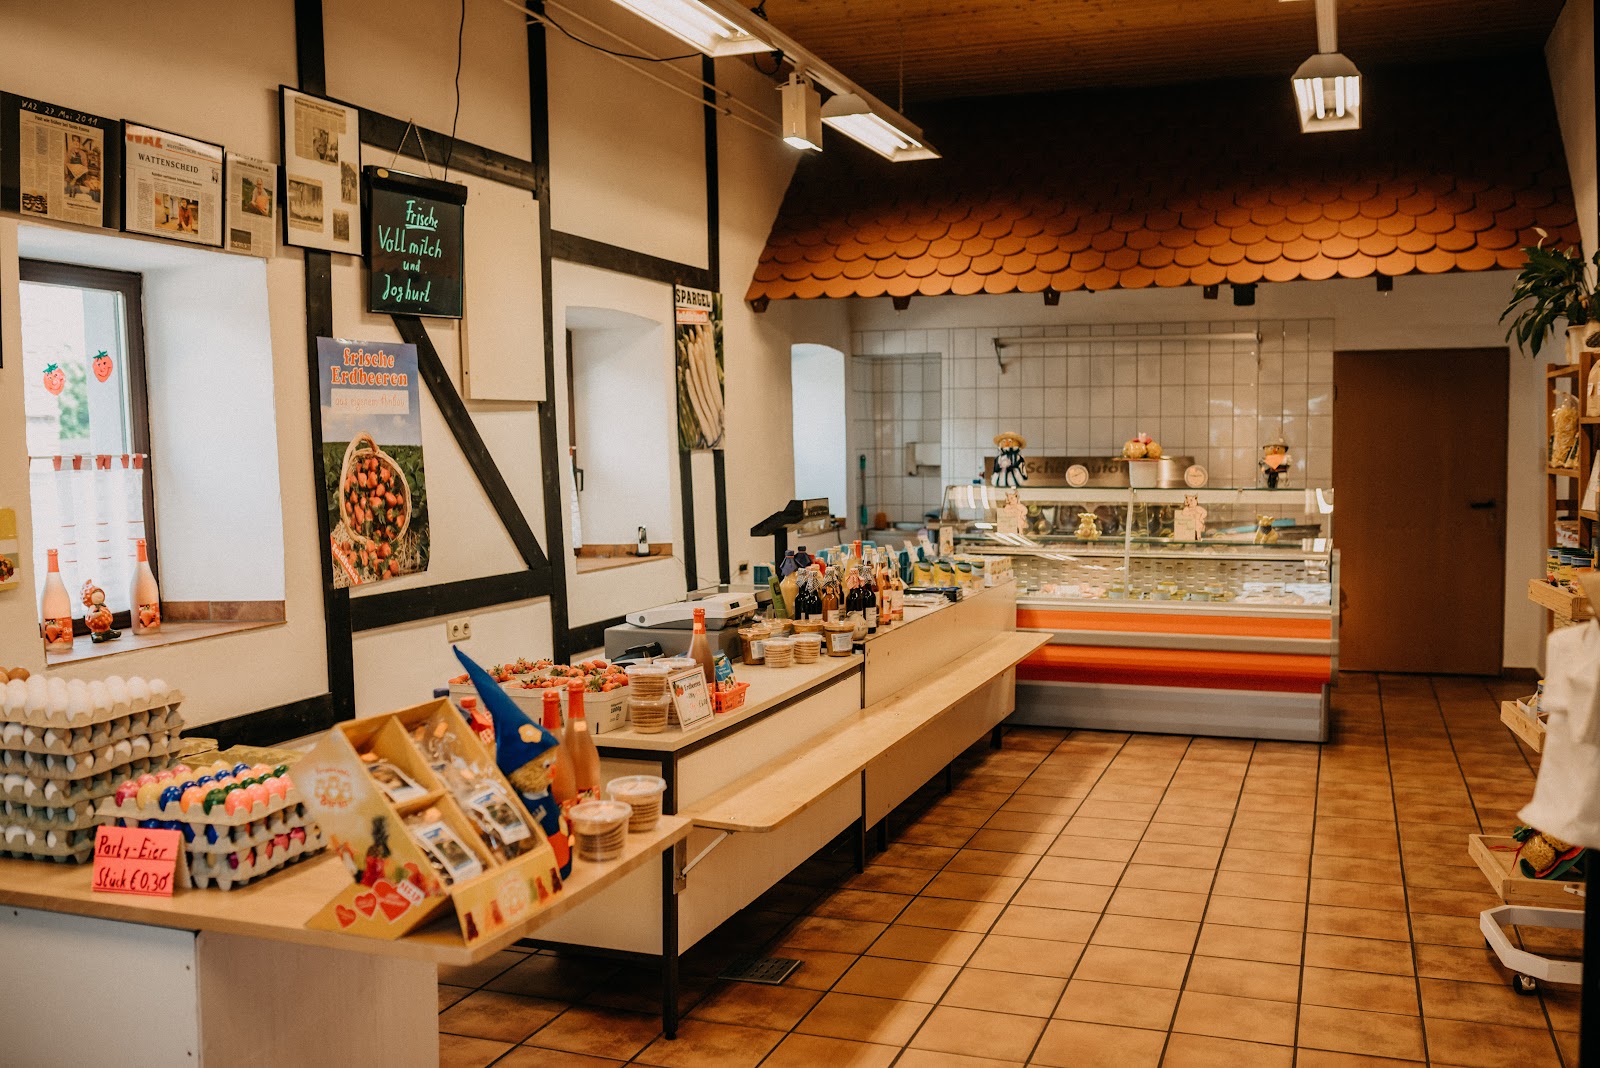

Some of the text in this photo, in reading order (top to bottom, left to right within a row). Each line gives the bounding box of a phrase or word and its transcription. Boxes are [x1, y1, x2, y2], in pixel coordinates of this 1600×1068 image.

[57, 110, 73, 120] Mai
[75, 113, 98, 126] 2011
[137, 152, 199, 174] WATTENSCHEID
[405, 200, 439, 228] Frische
[403, 259, 421, 273] und
[382, 274, 431, 303] Joghurt
[675, 288, 711, 308] SPARGEL
[343, 347, 395, 368] frische
[330, 366, 408, 386] Erdbeeren
[98, 835, 168, 860] Party-Eier
[95, 867, 127, 888] Stück
